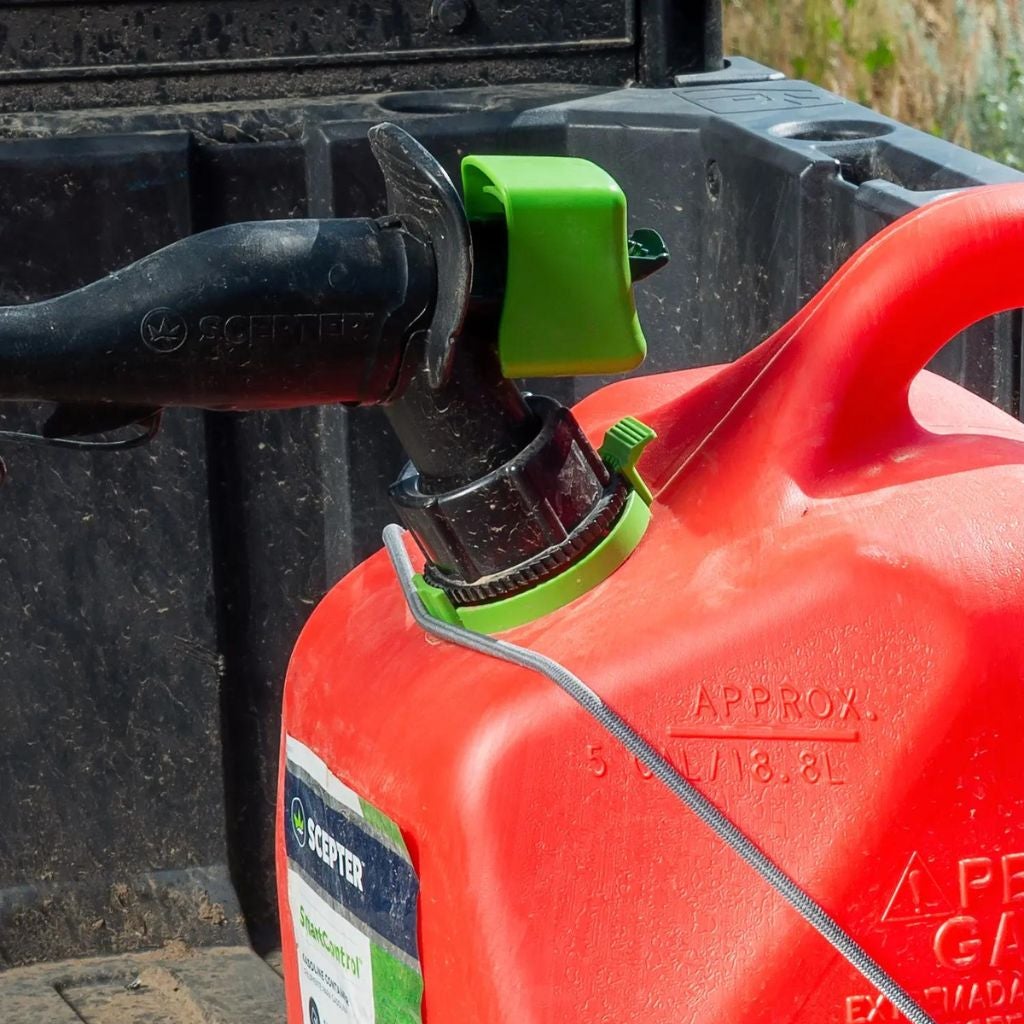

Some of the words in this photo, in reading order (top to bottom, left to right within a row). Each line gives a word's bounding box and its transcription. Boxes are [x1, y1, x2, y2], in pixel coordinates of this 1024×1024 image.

[198, 312, 369, 346] SCEPTER
[692, 683, 879, 721] APPROX.
[586, 744, 608, 778] 5
[307, 816, 364, 892] SCEPTER
[299, 903, 361, 980] SmartControl
